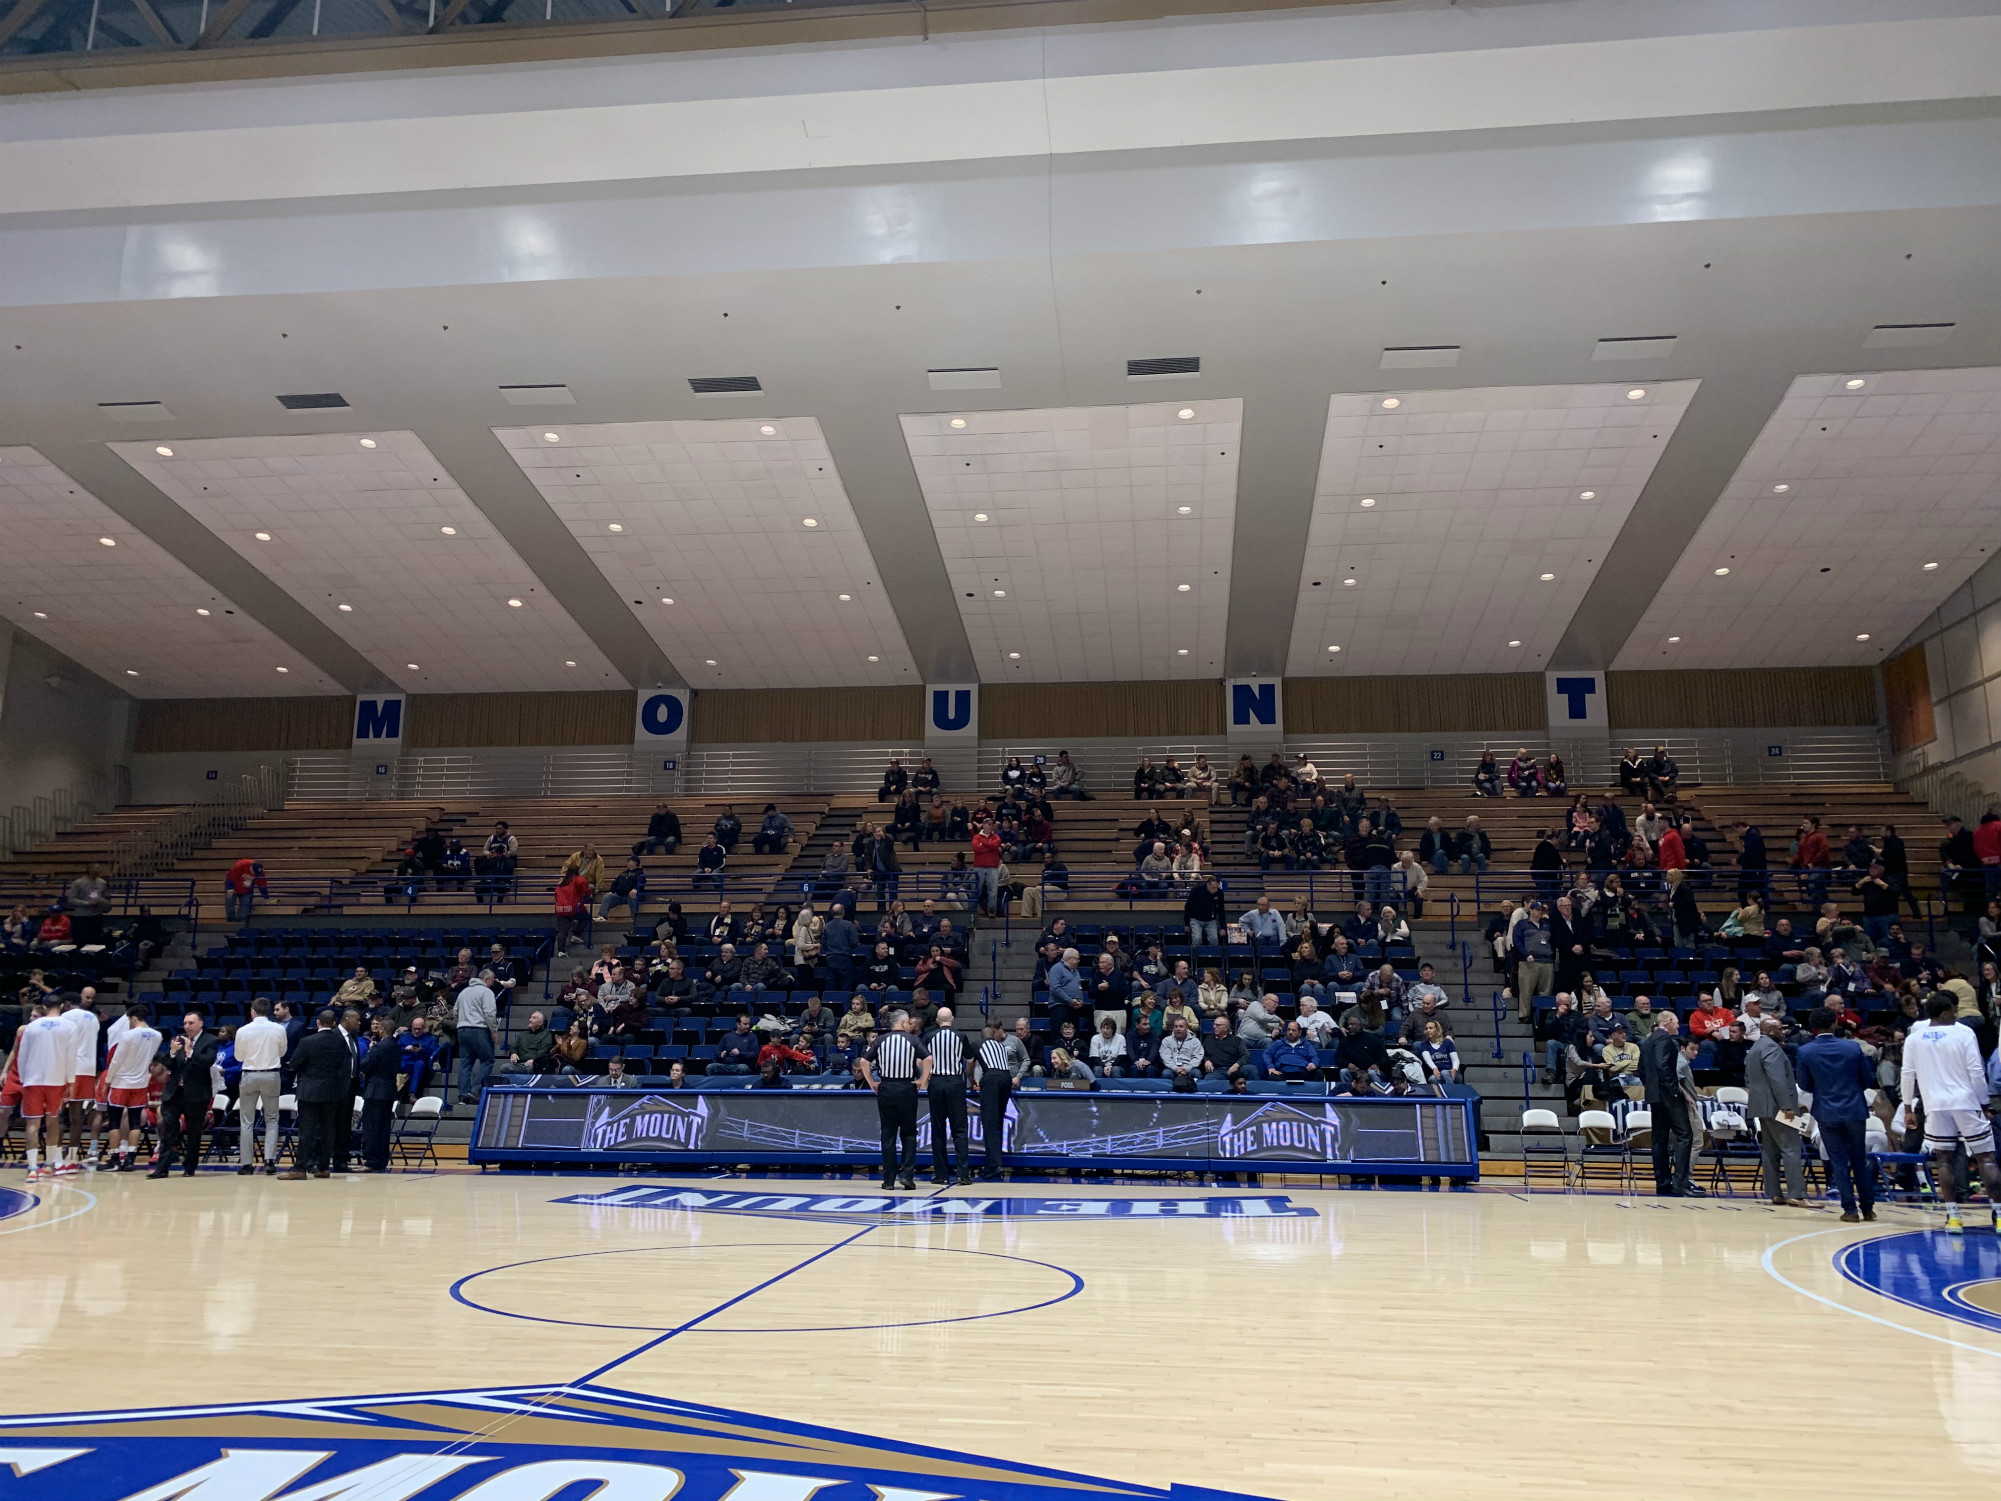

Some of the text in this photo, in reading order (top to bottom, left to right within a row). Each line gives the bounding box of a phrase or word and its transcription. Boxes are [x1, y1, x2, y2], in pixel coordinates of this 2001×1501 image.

[355, 677, 1596, 739] M O U N T
[1036, 756, 1045, 764] 20
[407, 886, 412, 895] 4
[803, 883, 809, 892] 6
[1060, 1081, 1075, 1089] POSS.
[596, 1112, 702, 1150] THE MOUNT
[1221, 1121, 1335, 1160] THE MOUNT
